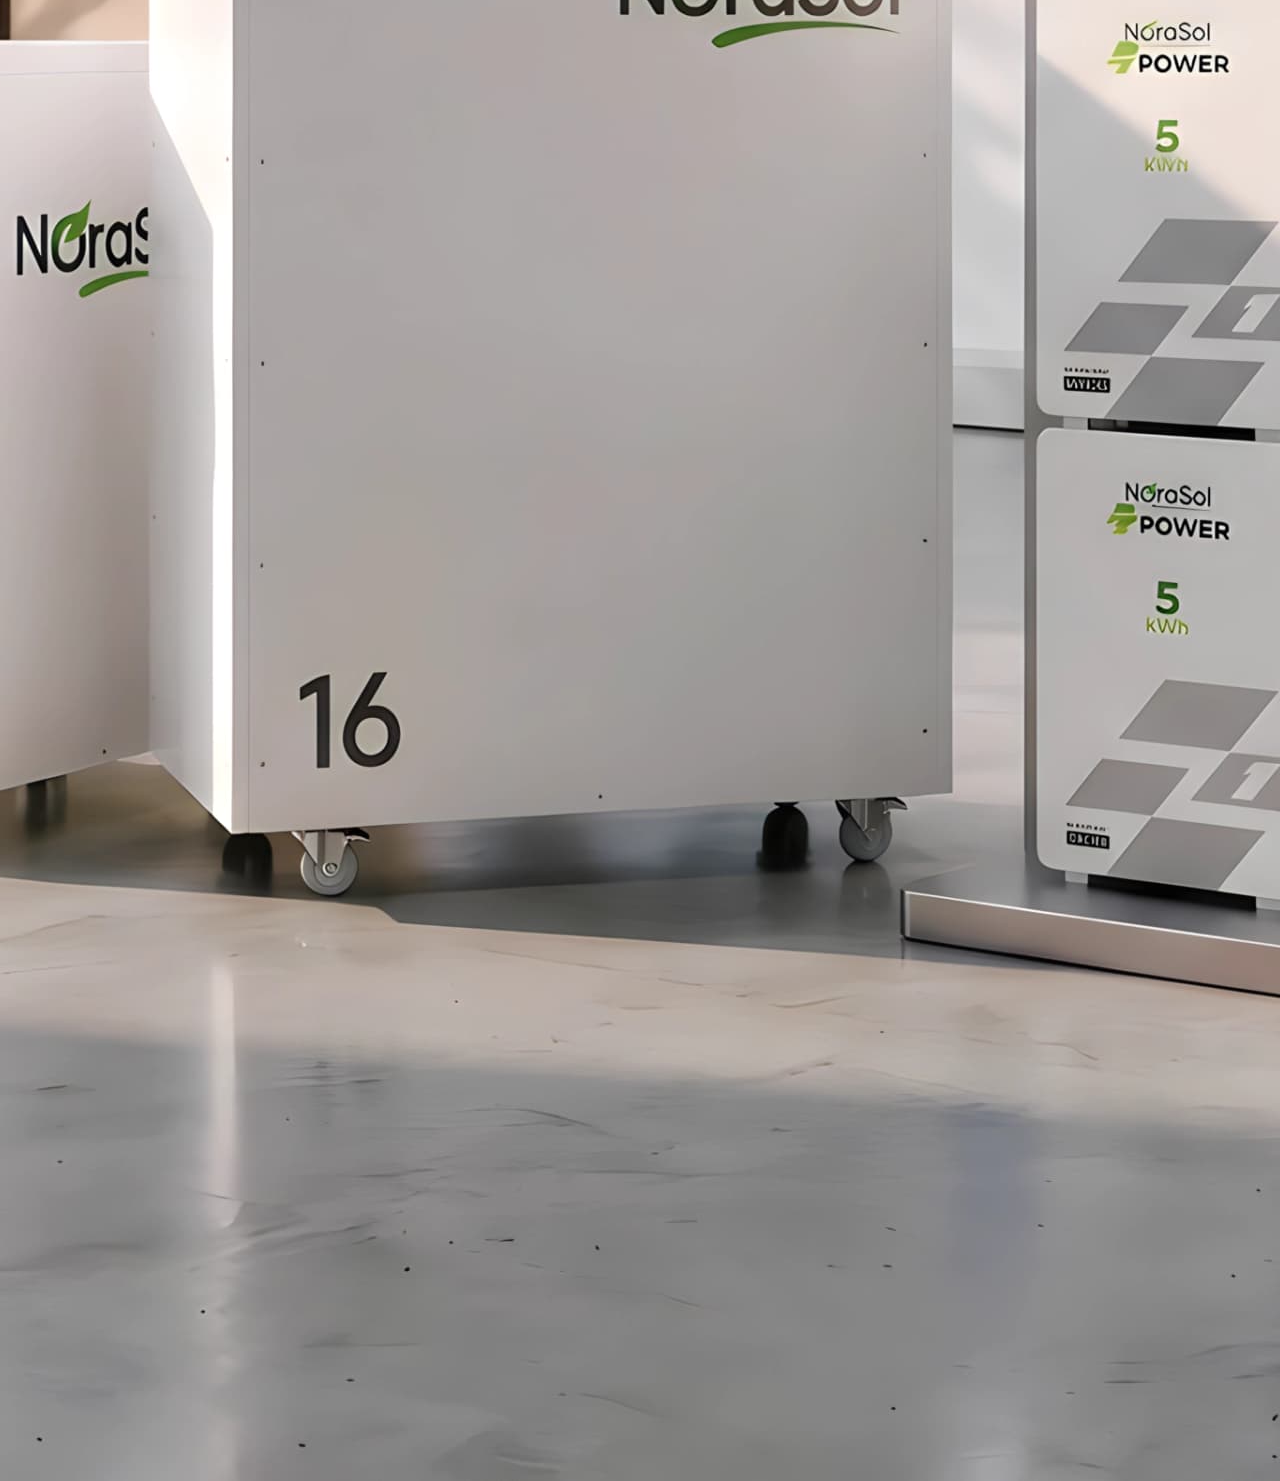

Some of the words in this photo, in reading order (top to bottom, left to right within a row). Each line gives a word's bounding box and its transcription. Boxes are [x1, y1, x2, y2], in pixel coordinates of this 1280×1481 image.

[1124, 20, 1211, 42] NoraSol
[1138, 54, 1230, 73] POWER
[1155, 119, 1181, 153] 5
[1139, 515, 1231, 541] POWER
[1155, 580, 1181, 615] 5
[1145, 616, 1189, 636] kWh
[298, 671, 403, 769] 16
